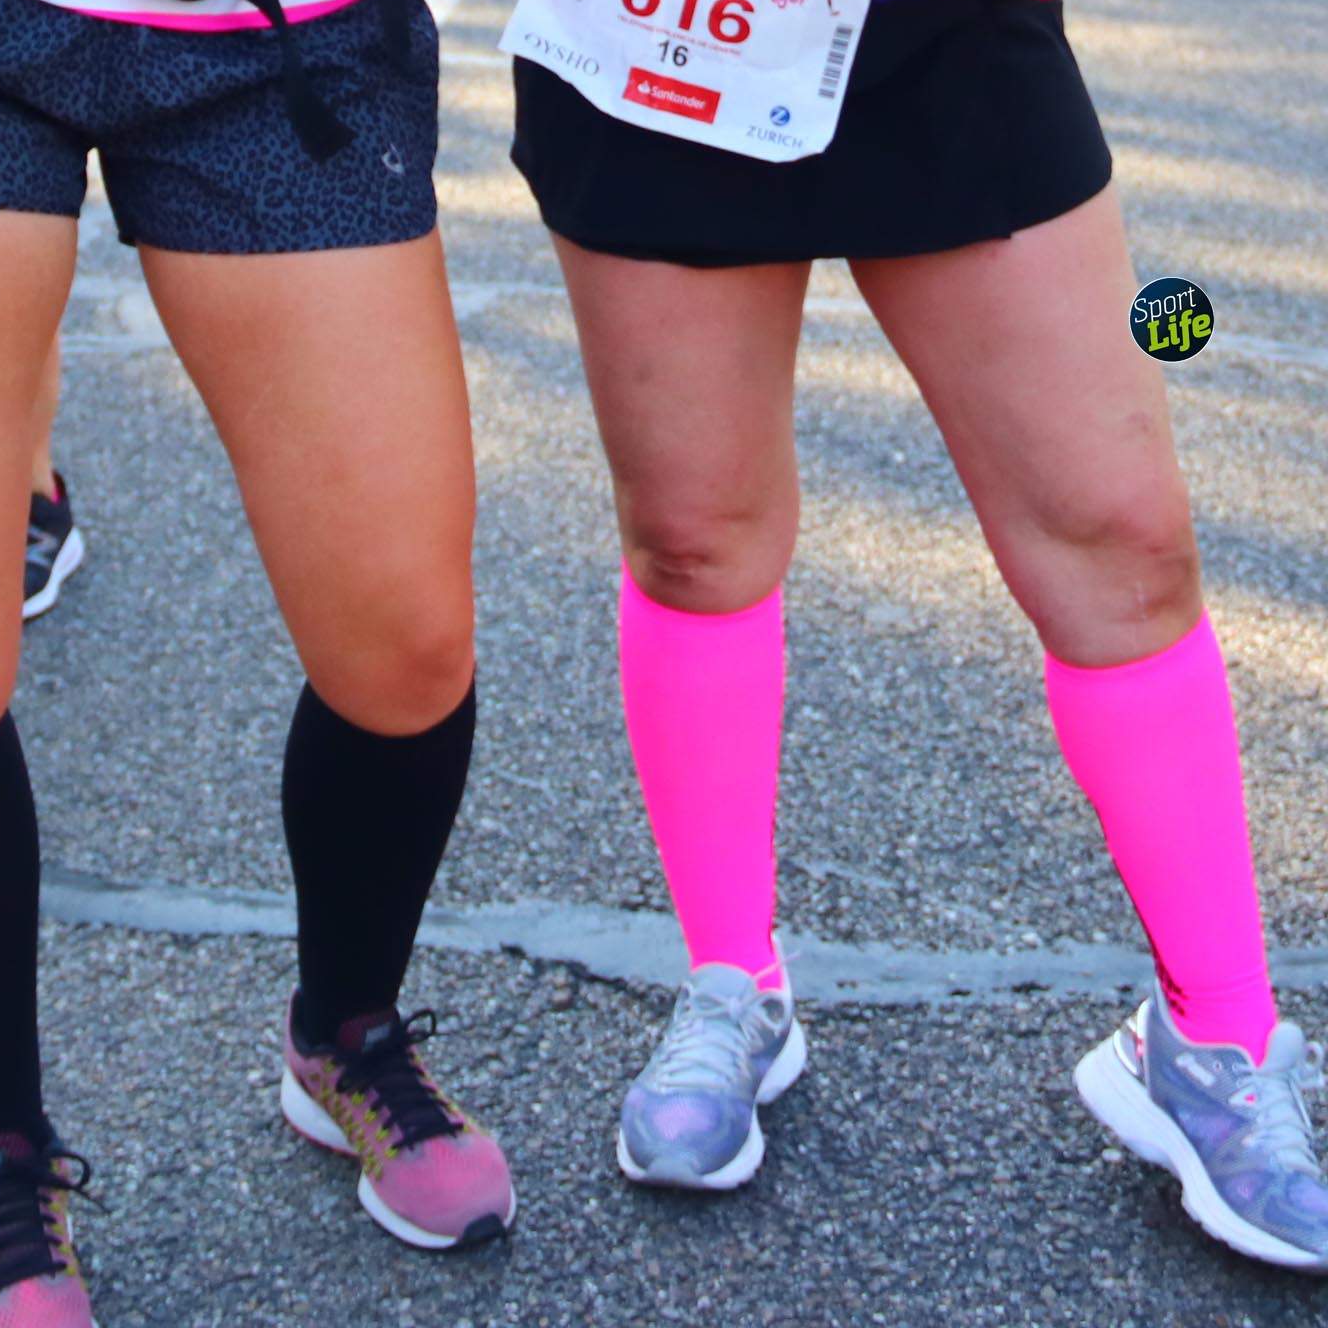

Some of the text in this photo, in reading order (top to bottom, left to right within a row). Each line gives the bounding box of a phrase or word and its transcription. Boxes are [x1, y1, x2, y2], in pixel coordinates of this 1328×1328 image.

[523, 30, 600, 78] OYSHO
[658, 39, 689, 67] 16
[651, 84, 707, 110] Santander
[745, 124, 804, 149] ZURICH
